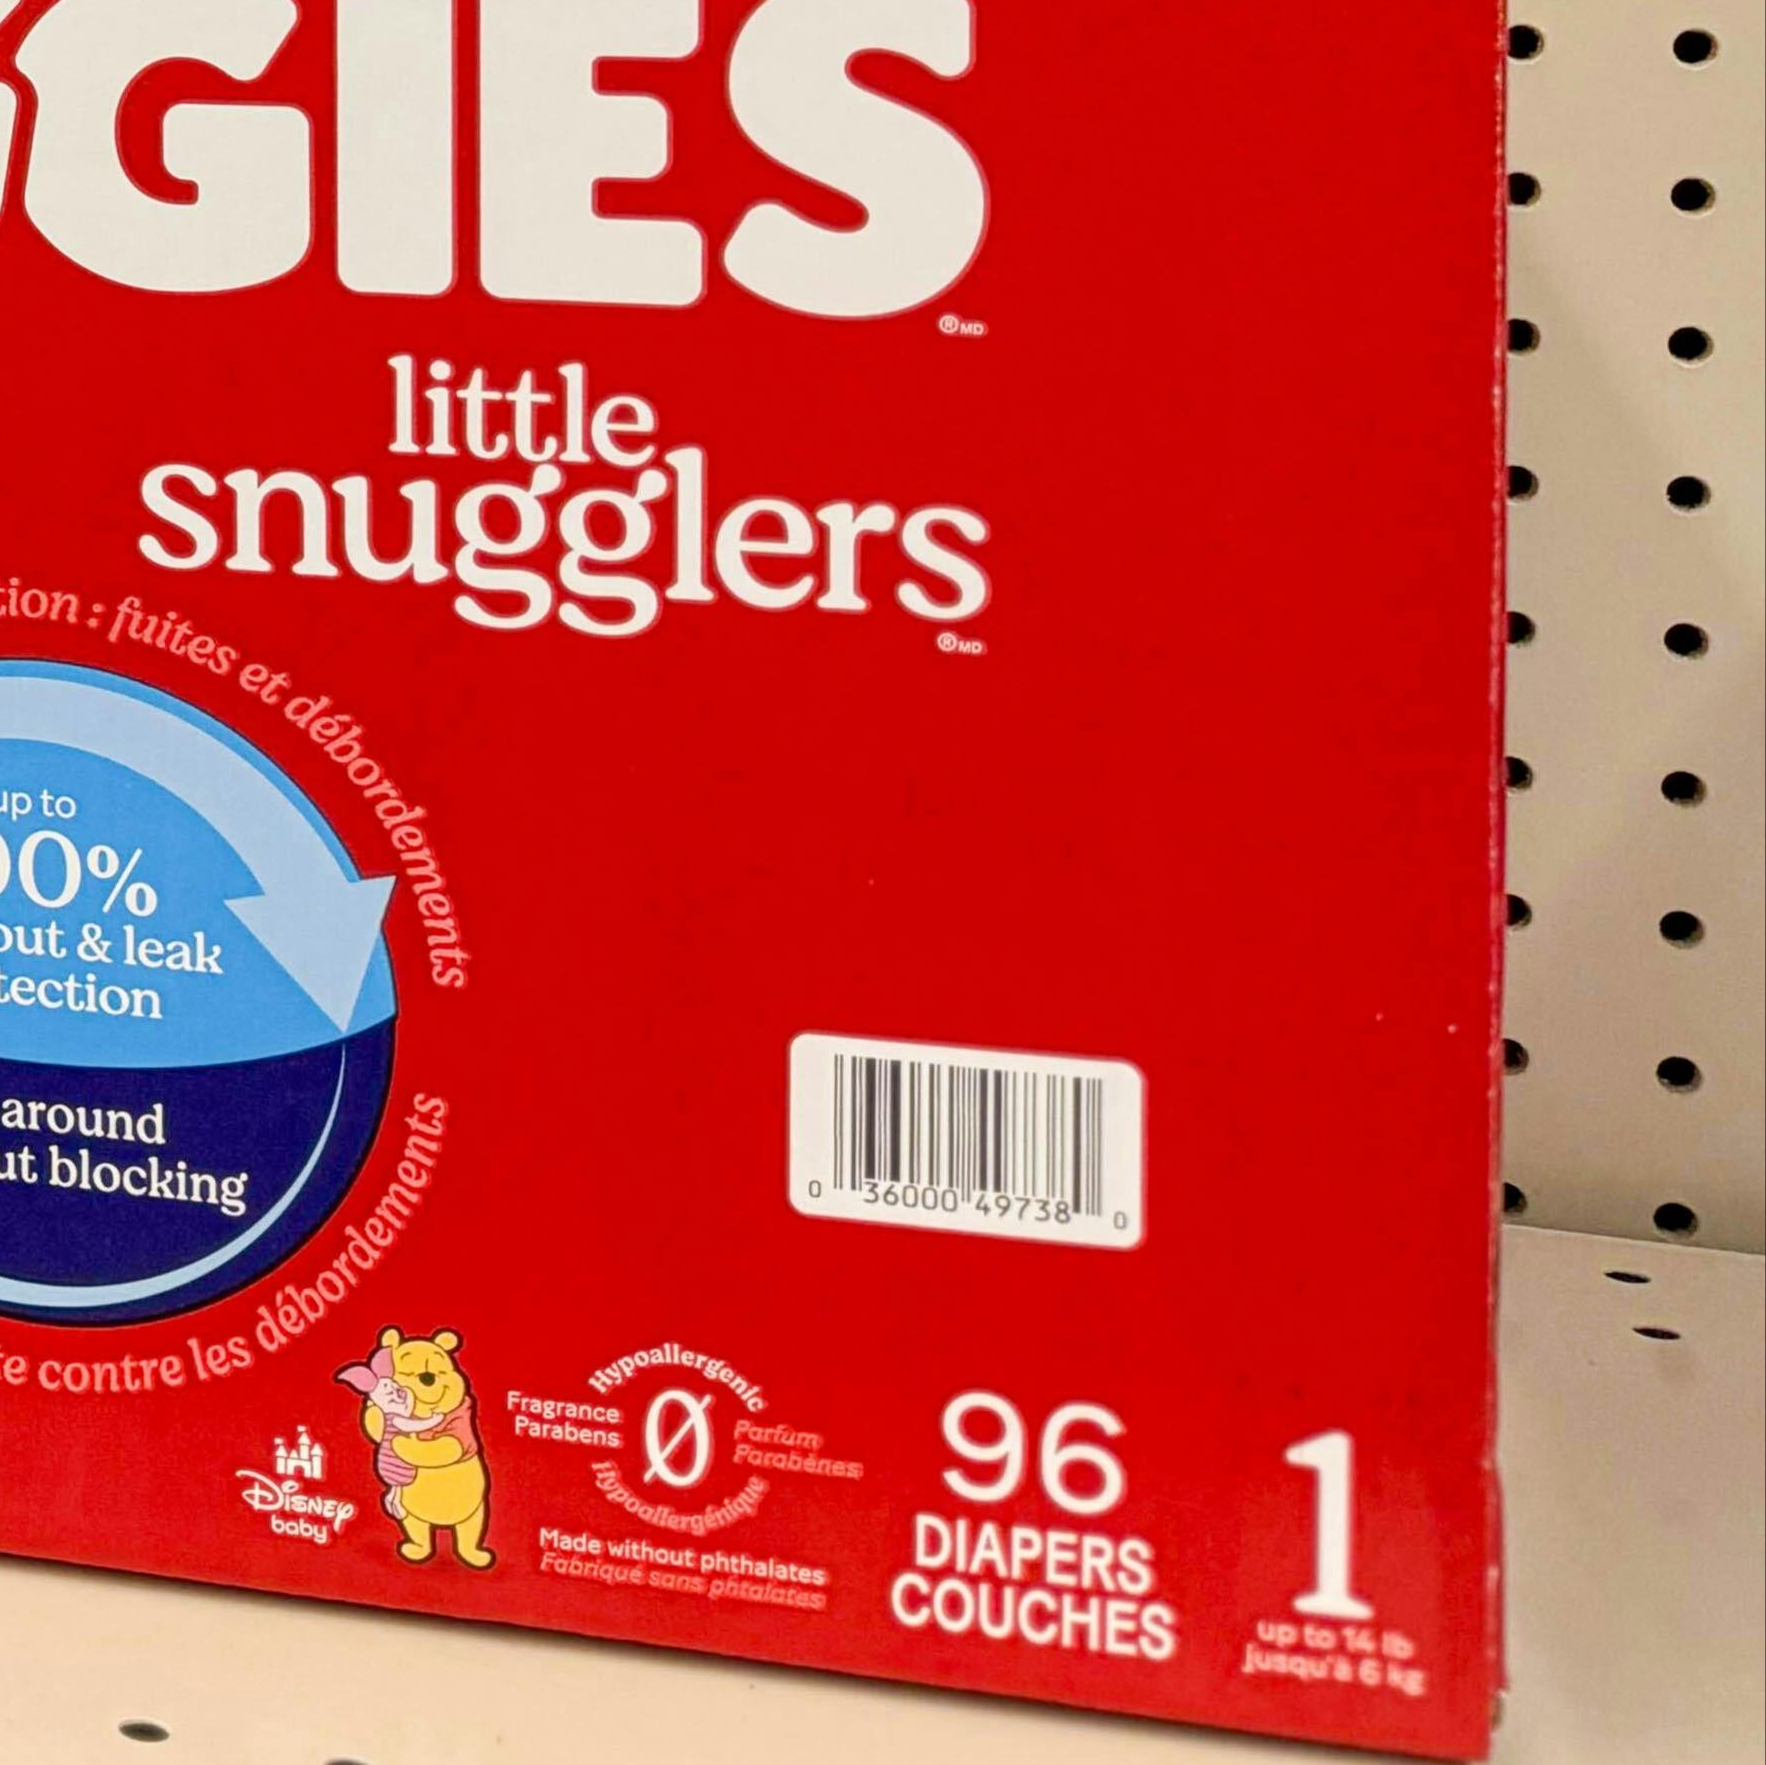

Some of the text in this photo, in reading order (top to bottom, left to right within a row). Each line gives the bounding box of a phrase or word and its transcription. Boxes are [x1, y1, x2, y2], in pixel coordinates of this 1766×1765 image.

[388, 355, 658, 466] little
[137, 446, 988, 637] snugglers
[38, 788, 77, 820] to
[106, 595, 236, 683] fuites
[237, 659, 290, 708] et
[283, 685, 467, 990] débordements
[76, 923, 113, 964] &
[123, 926, 224, 977] leak
[48, 1145, 249, 1216] blocking
[809, 1180, 1128, 1230] 0 36000 49738 0
[38, 1347, 185, 1395] contre
[189, 1335, 252, 1383] les
[255, 1091, 450, 1353] débordements
[506, 1390, 621, 1423] Fragrance
[587, 1343, 767, 1413] Hypoallergenic
[515, 1416, 621, 1448] Parabens
[943, 1392, 1123, 1514] 96
[271, 1514, 328, 1544] baby
[540, 1528, 827, 1587] Made without phthalates
[915, 1513, 1153, 1594] DIAPERS
[1285, 1428, 1376, 1620] 1
[890, 1572, 1175, 1661] COUCHES
[1256, 1620, 1298, 1647] up
[1303, 1623, 1337, 1650] to
[1358, 1657, 1382, 1686] 6
